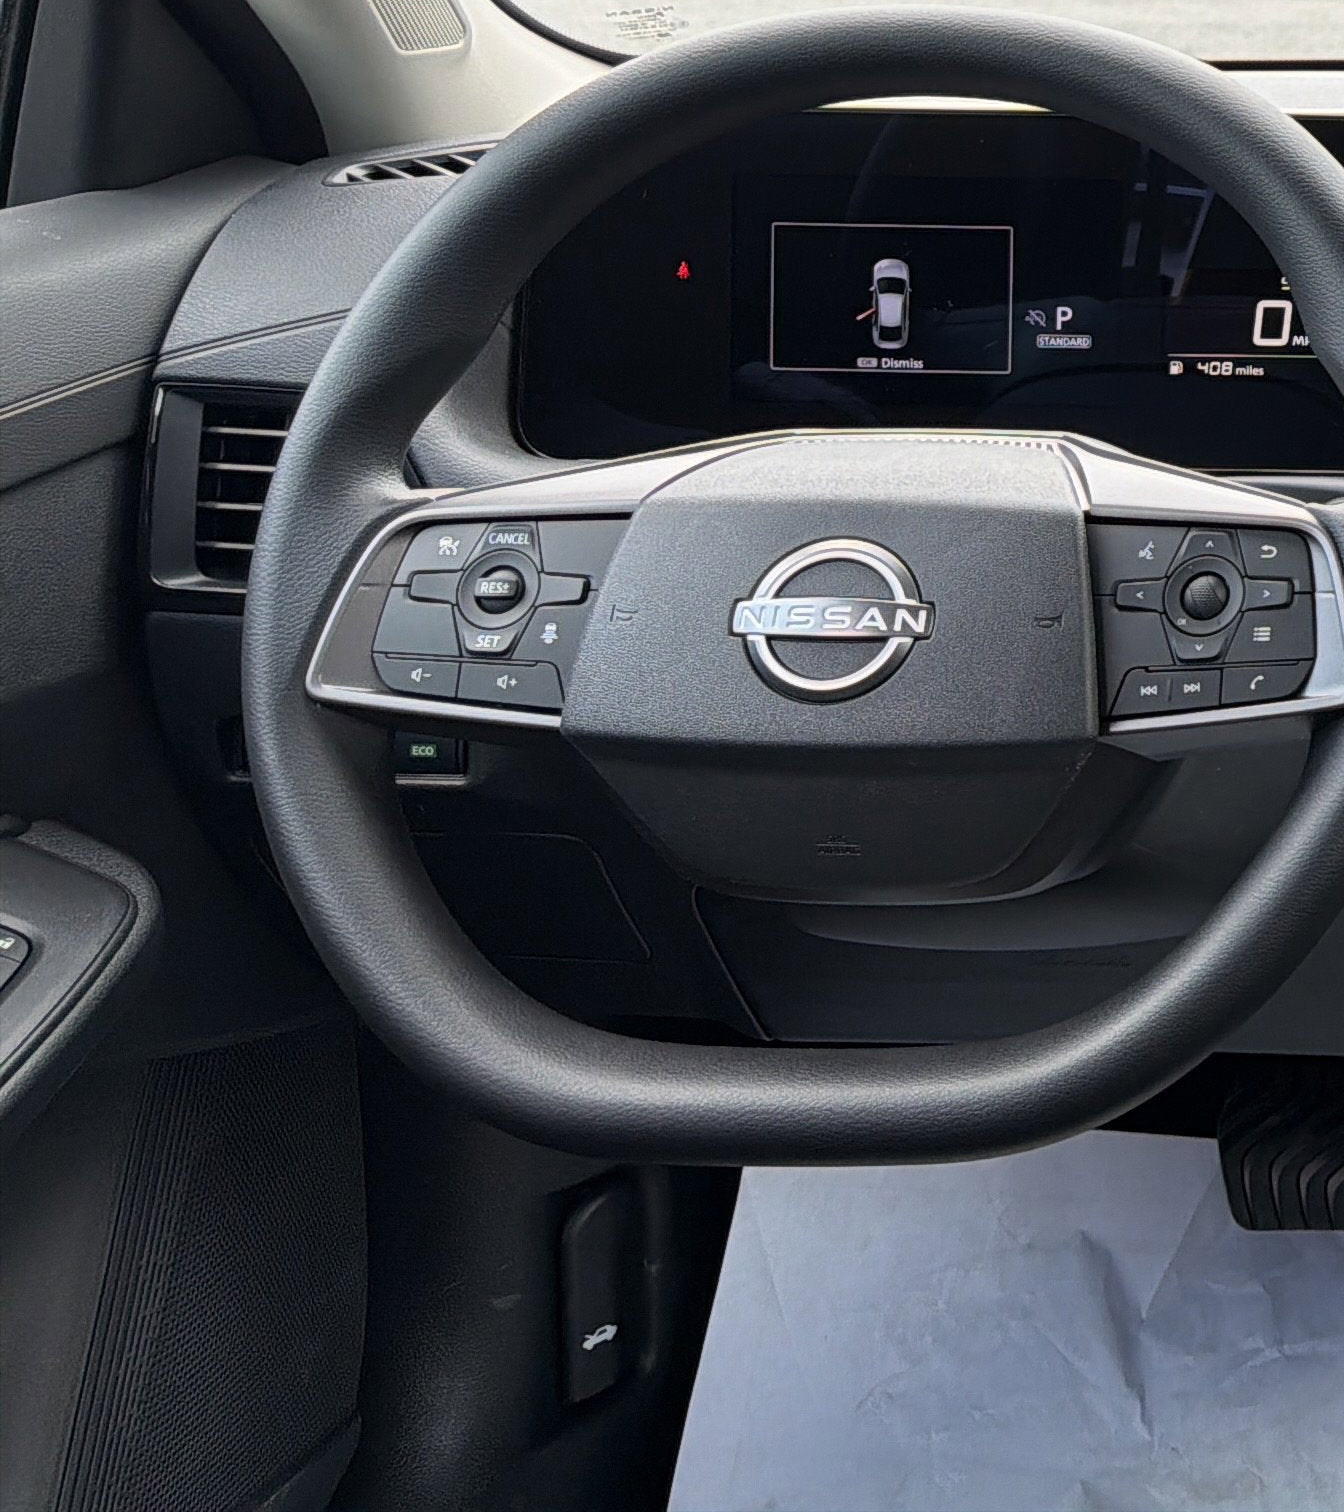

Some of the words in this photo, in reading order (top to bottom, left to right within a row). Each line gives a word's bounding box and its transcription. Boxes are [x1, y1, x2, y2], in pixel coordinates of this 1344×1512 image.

[1056, 306, 1073, 330] P
[1253, 300, 1293, 346] 0
[1039, 336, 1090, 347] STANDARD
[881, 357, 924, 369] Dismiss
[1197, 361, 1233, 376] 408
[1235, 364, 1264, 376] miles
[488, 532, 531, 545] CANCEL
[738, 604, 928, 633] NISSAN
[475, 635, 501, 648] SET
[412, 745, 435, 757] ECO
